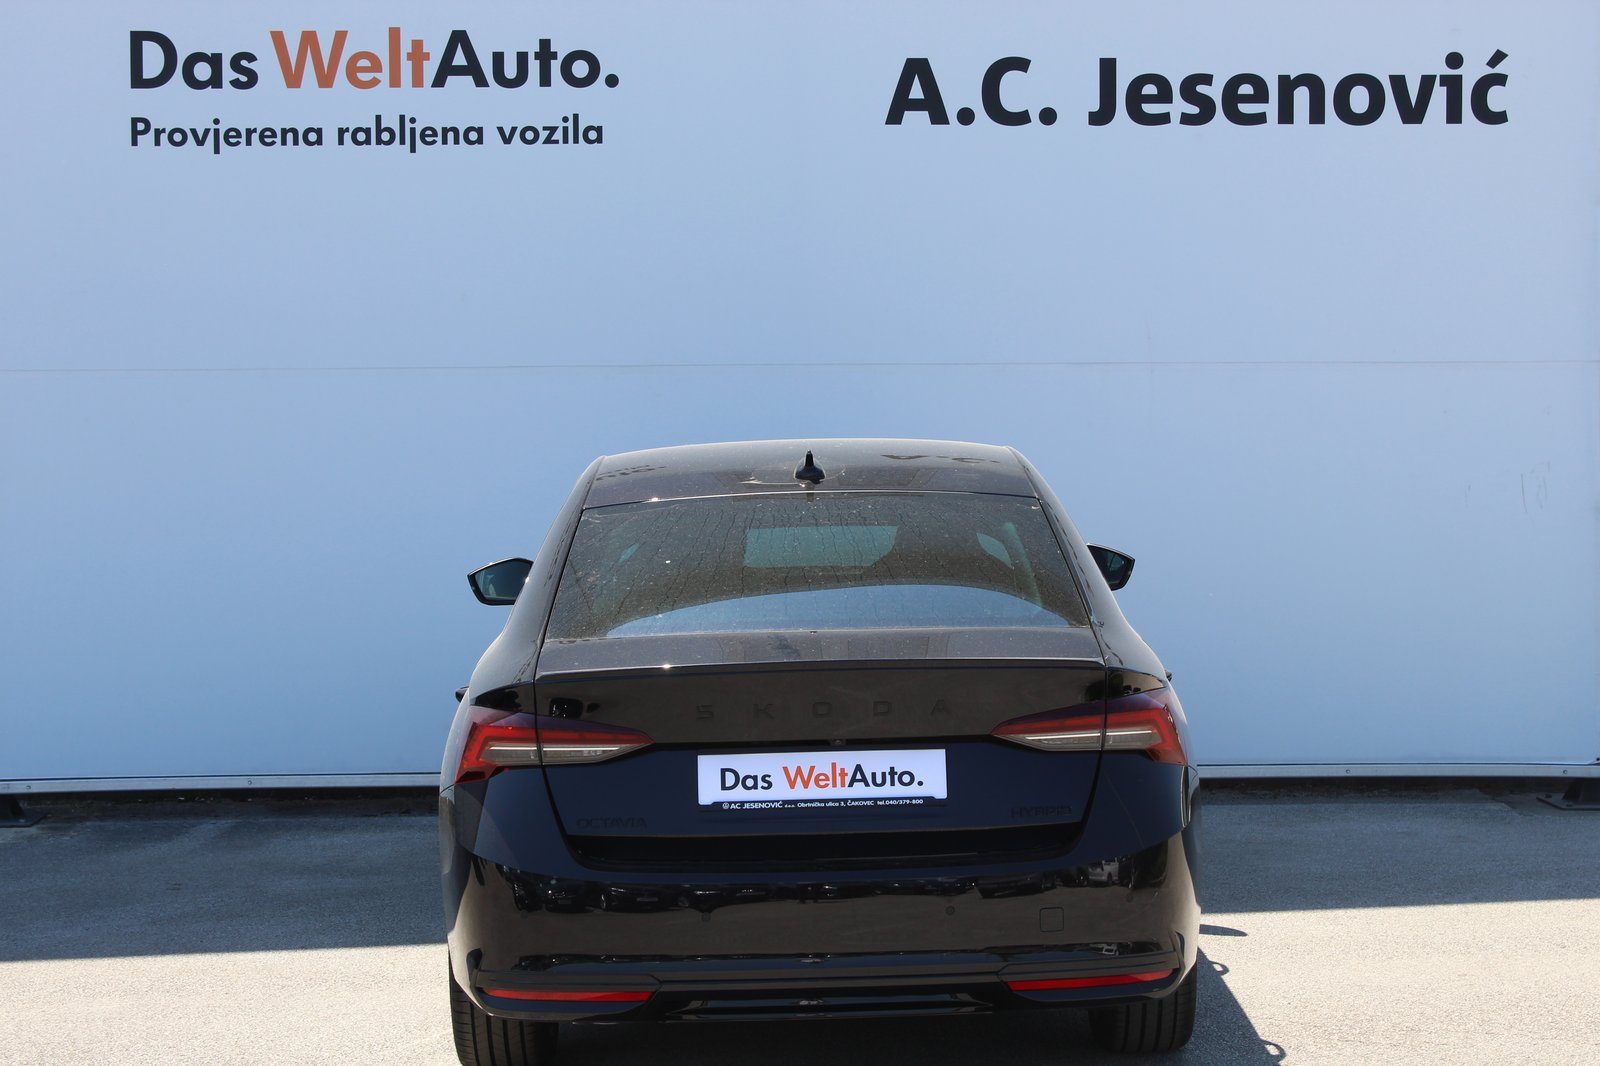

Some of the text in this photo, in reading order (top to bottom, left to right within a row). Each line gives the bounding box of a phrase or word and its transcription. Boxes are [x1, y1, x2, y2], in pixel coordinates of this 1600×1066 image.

[130, 28, 620, 90] Das WeltAuto.
[885, 49, 1509, 126] A.C. Jesenović
[131, 113, 603, 155] Provjerena rabljena vozila
[720, 762, 924, 791] Das WeltAuto.
[743, 801, 783, 809] JESENOVIĆ
